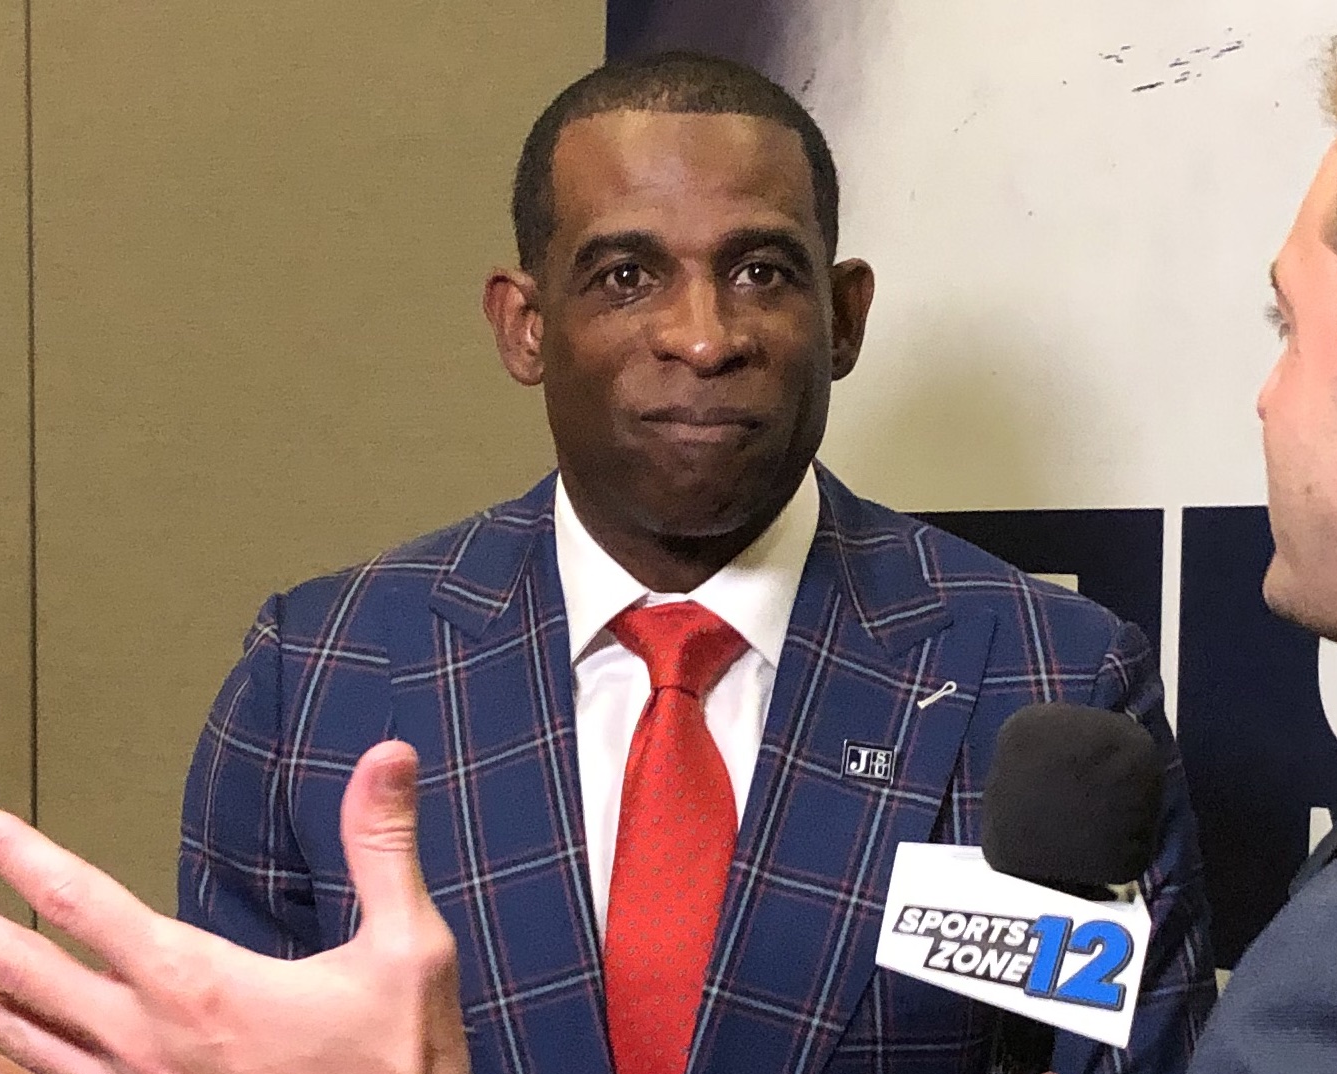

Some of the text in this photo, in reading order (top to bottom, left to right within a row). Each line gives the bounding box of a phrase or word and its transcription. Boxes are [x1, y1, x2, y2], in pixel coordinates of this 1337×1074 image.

[897, 907, 1030, 947] SPORTS
[928, 941, 1032, 984] ZONE
[1024, 914, 1135, 1012] 12
